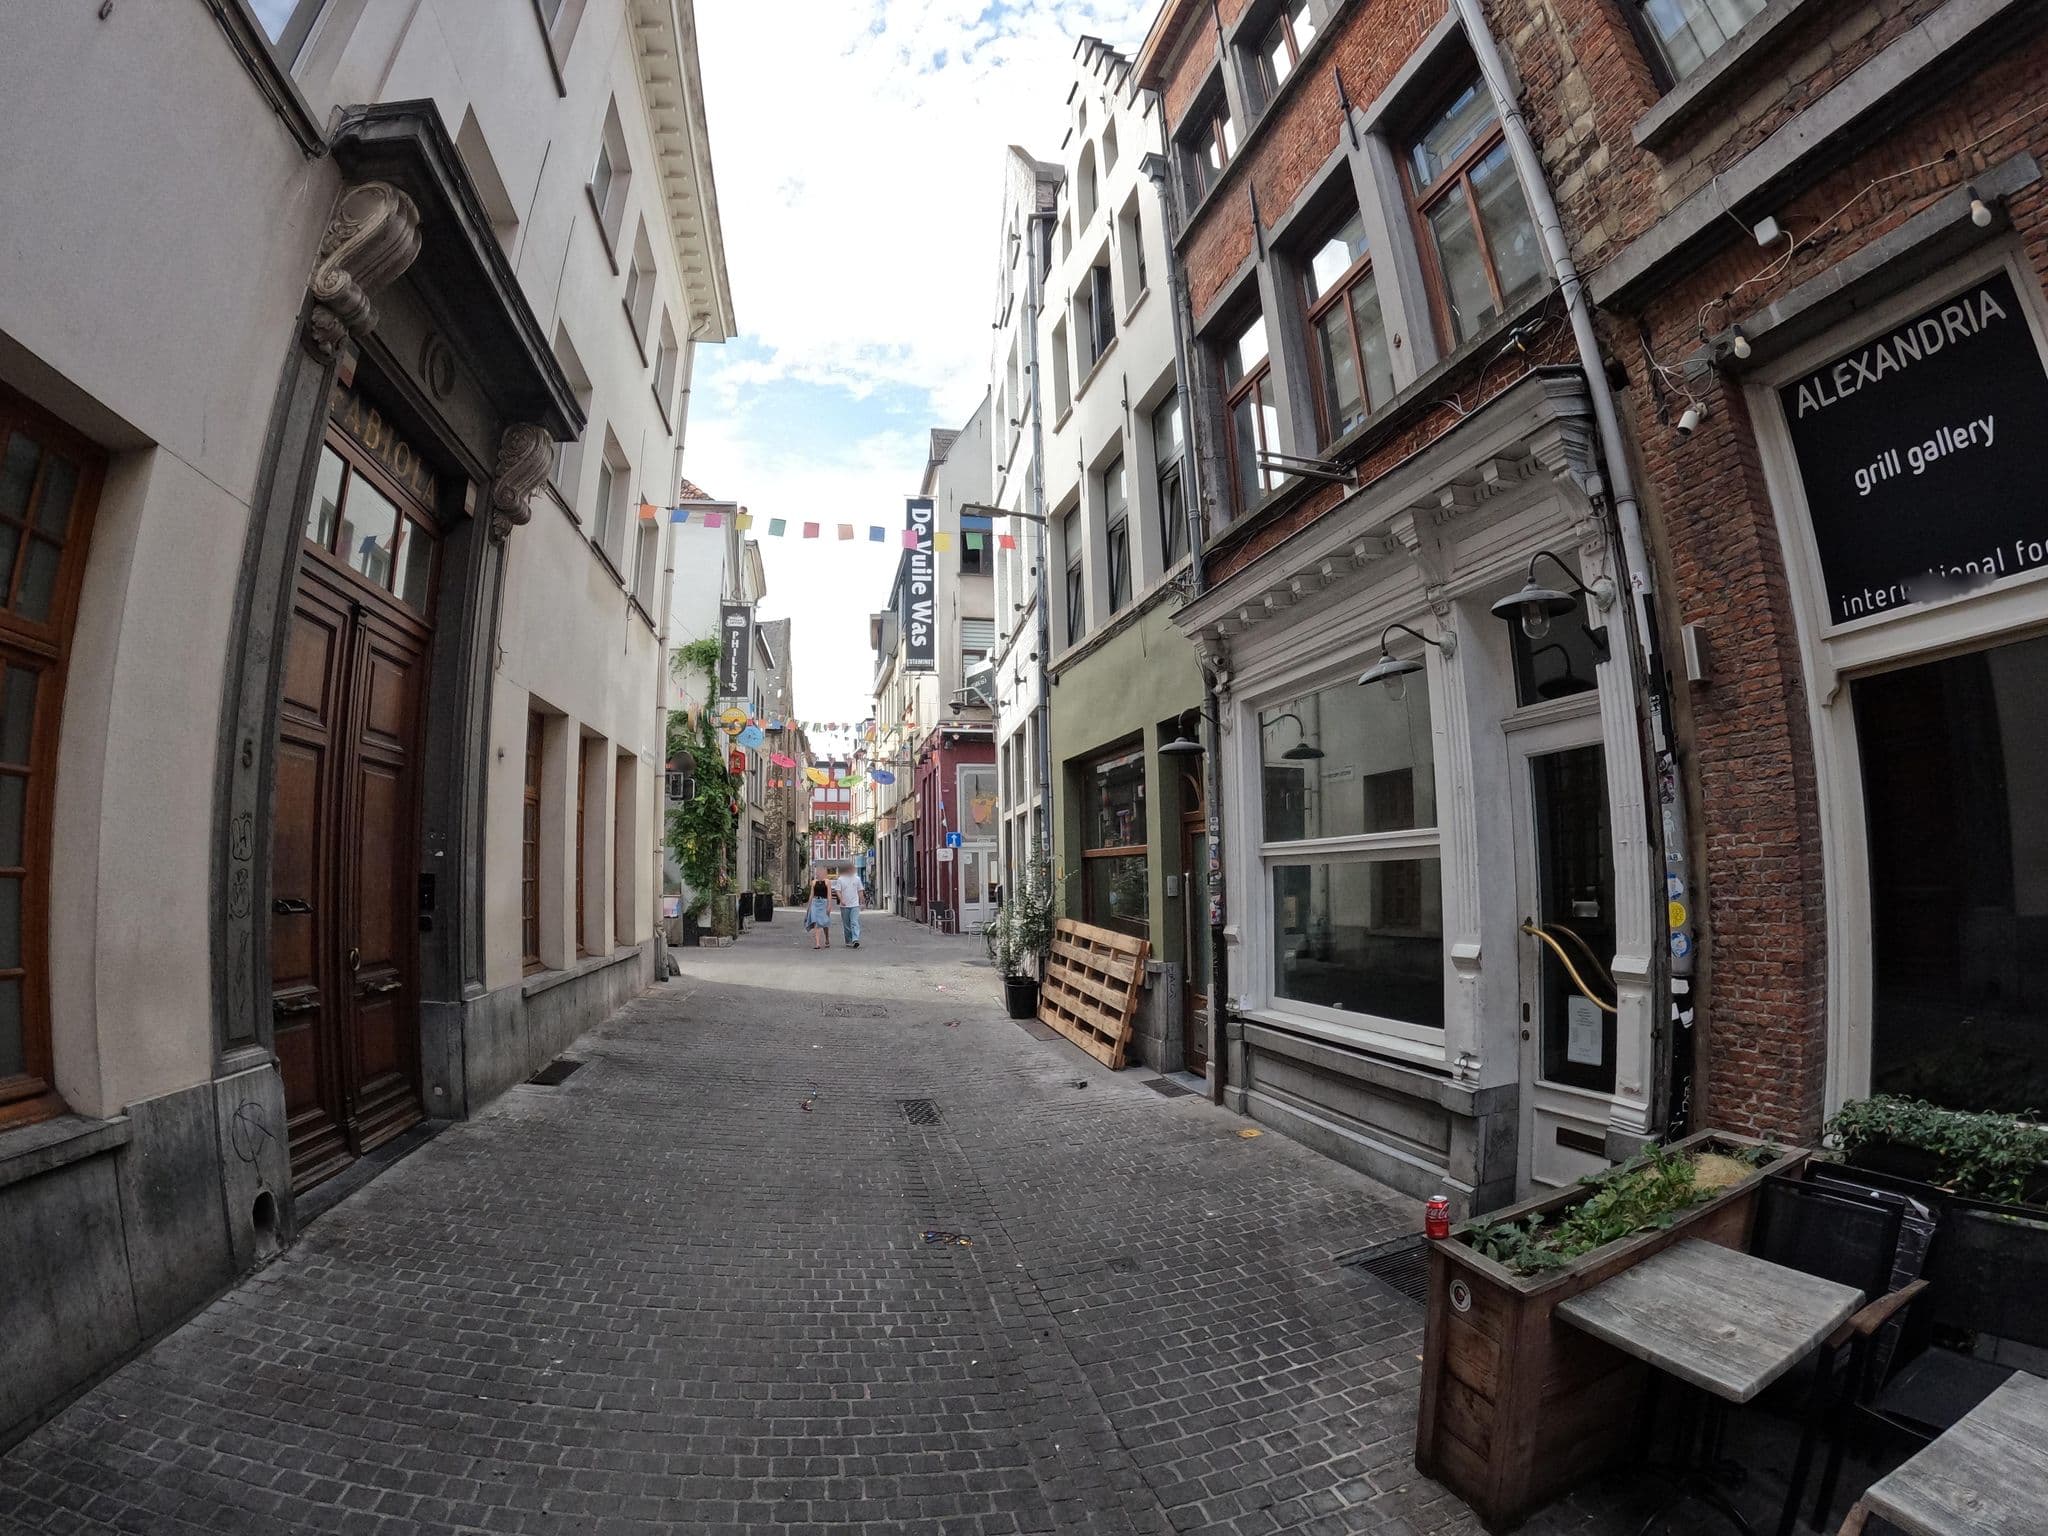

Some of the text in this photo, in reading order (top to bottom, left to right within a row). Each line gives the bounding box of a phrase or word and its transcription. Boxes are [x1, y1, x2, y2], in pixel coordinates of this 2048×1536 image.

[1798, 290, 2006, 418] ALEXANDRIA
[1854, 415, 1994, 496] grill gallery
[911, 508, 932, 647] De Vuile Was
[2015, 540, 2048, 566] fo
[729, 631, 739, 692] PHILLY'S
